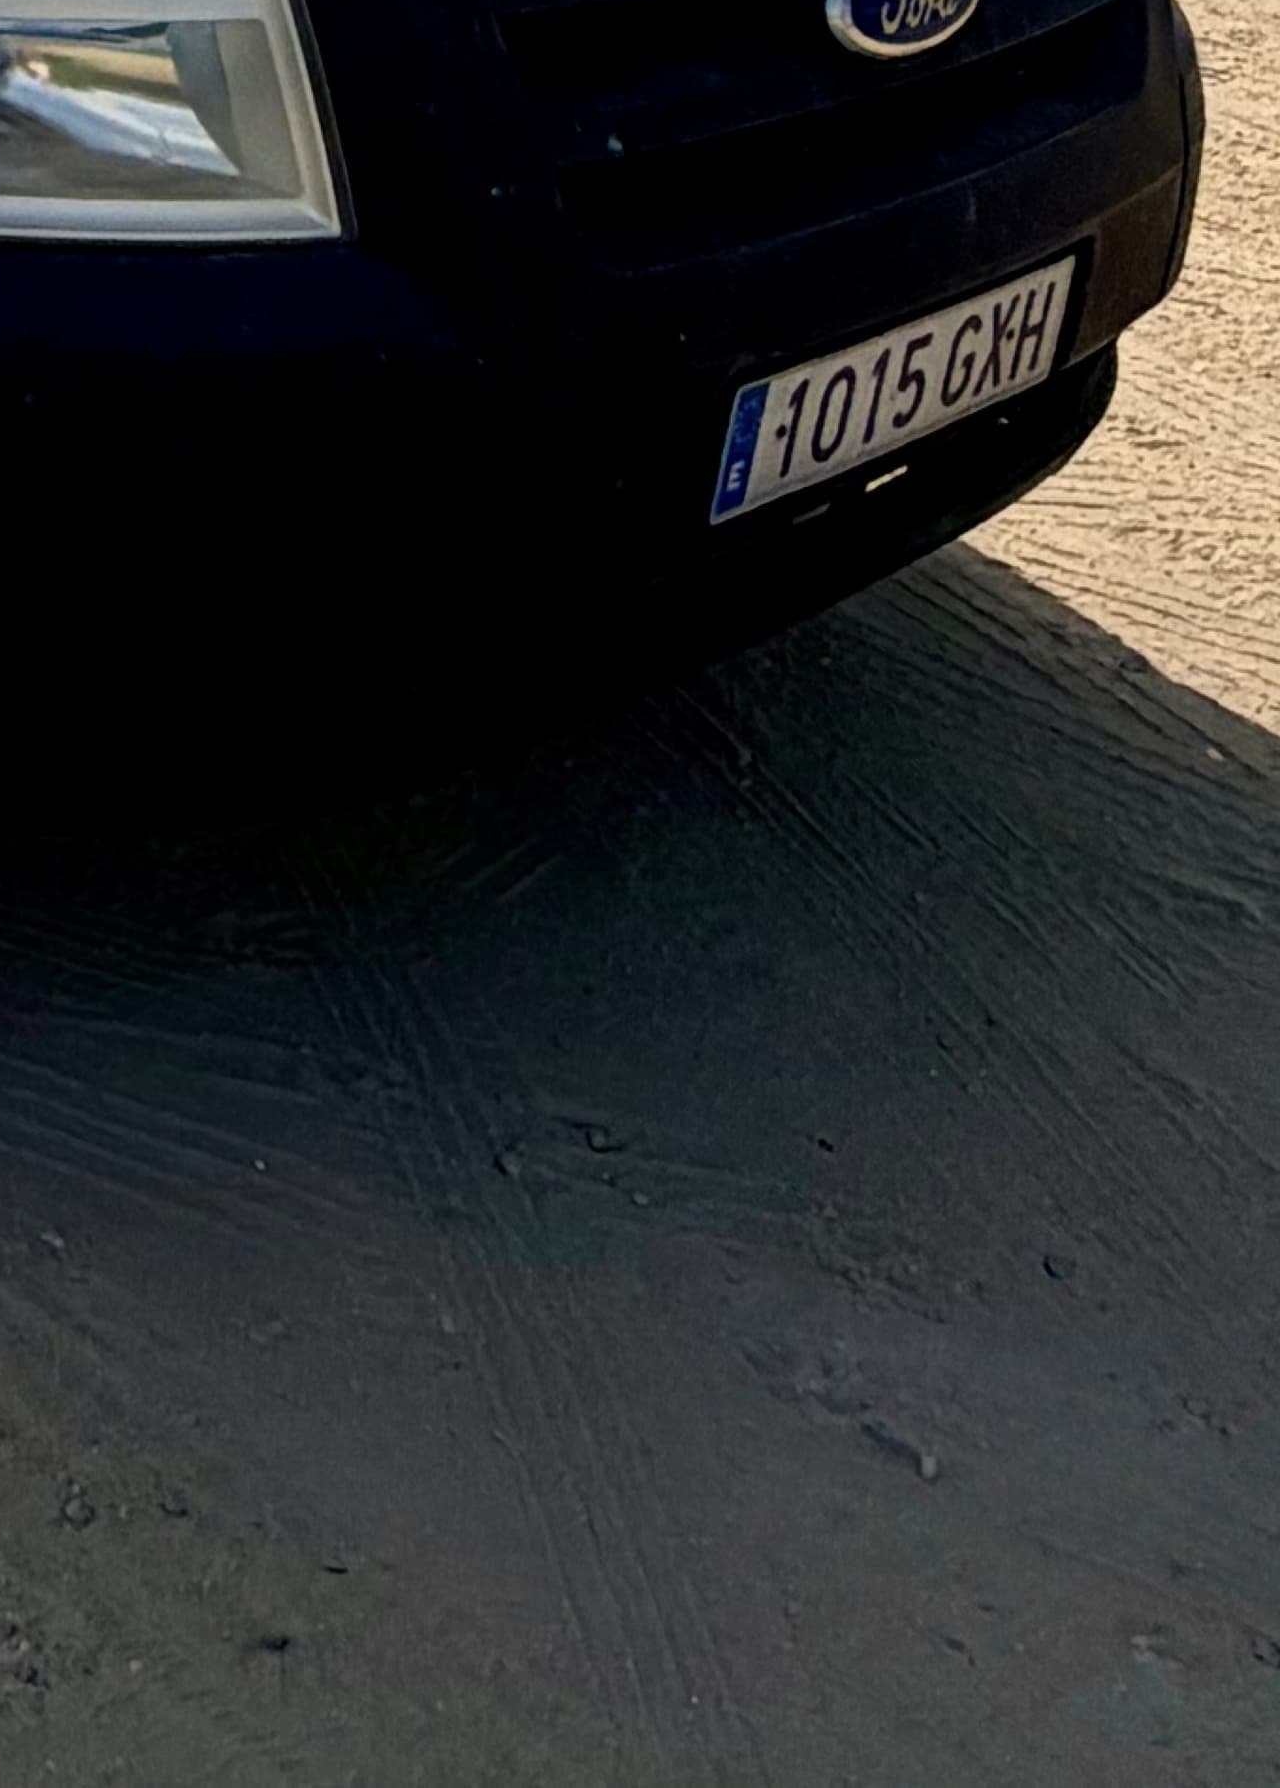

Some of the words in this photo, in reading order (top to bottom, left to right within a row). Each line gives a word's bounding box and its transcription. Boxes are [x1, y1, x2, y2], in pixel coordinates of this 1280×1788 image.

[726, 459, 746, 493] E
[779, 331, 933, 478] 1015
[940, 281, 1056, 409] GXH
